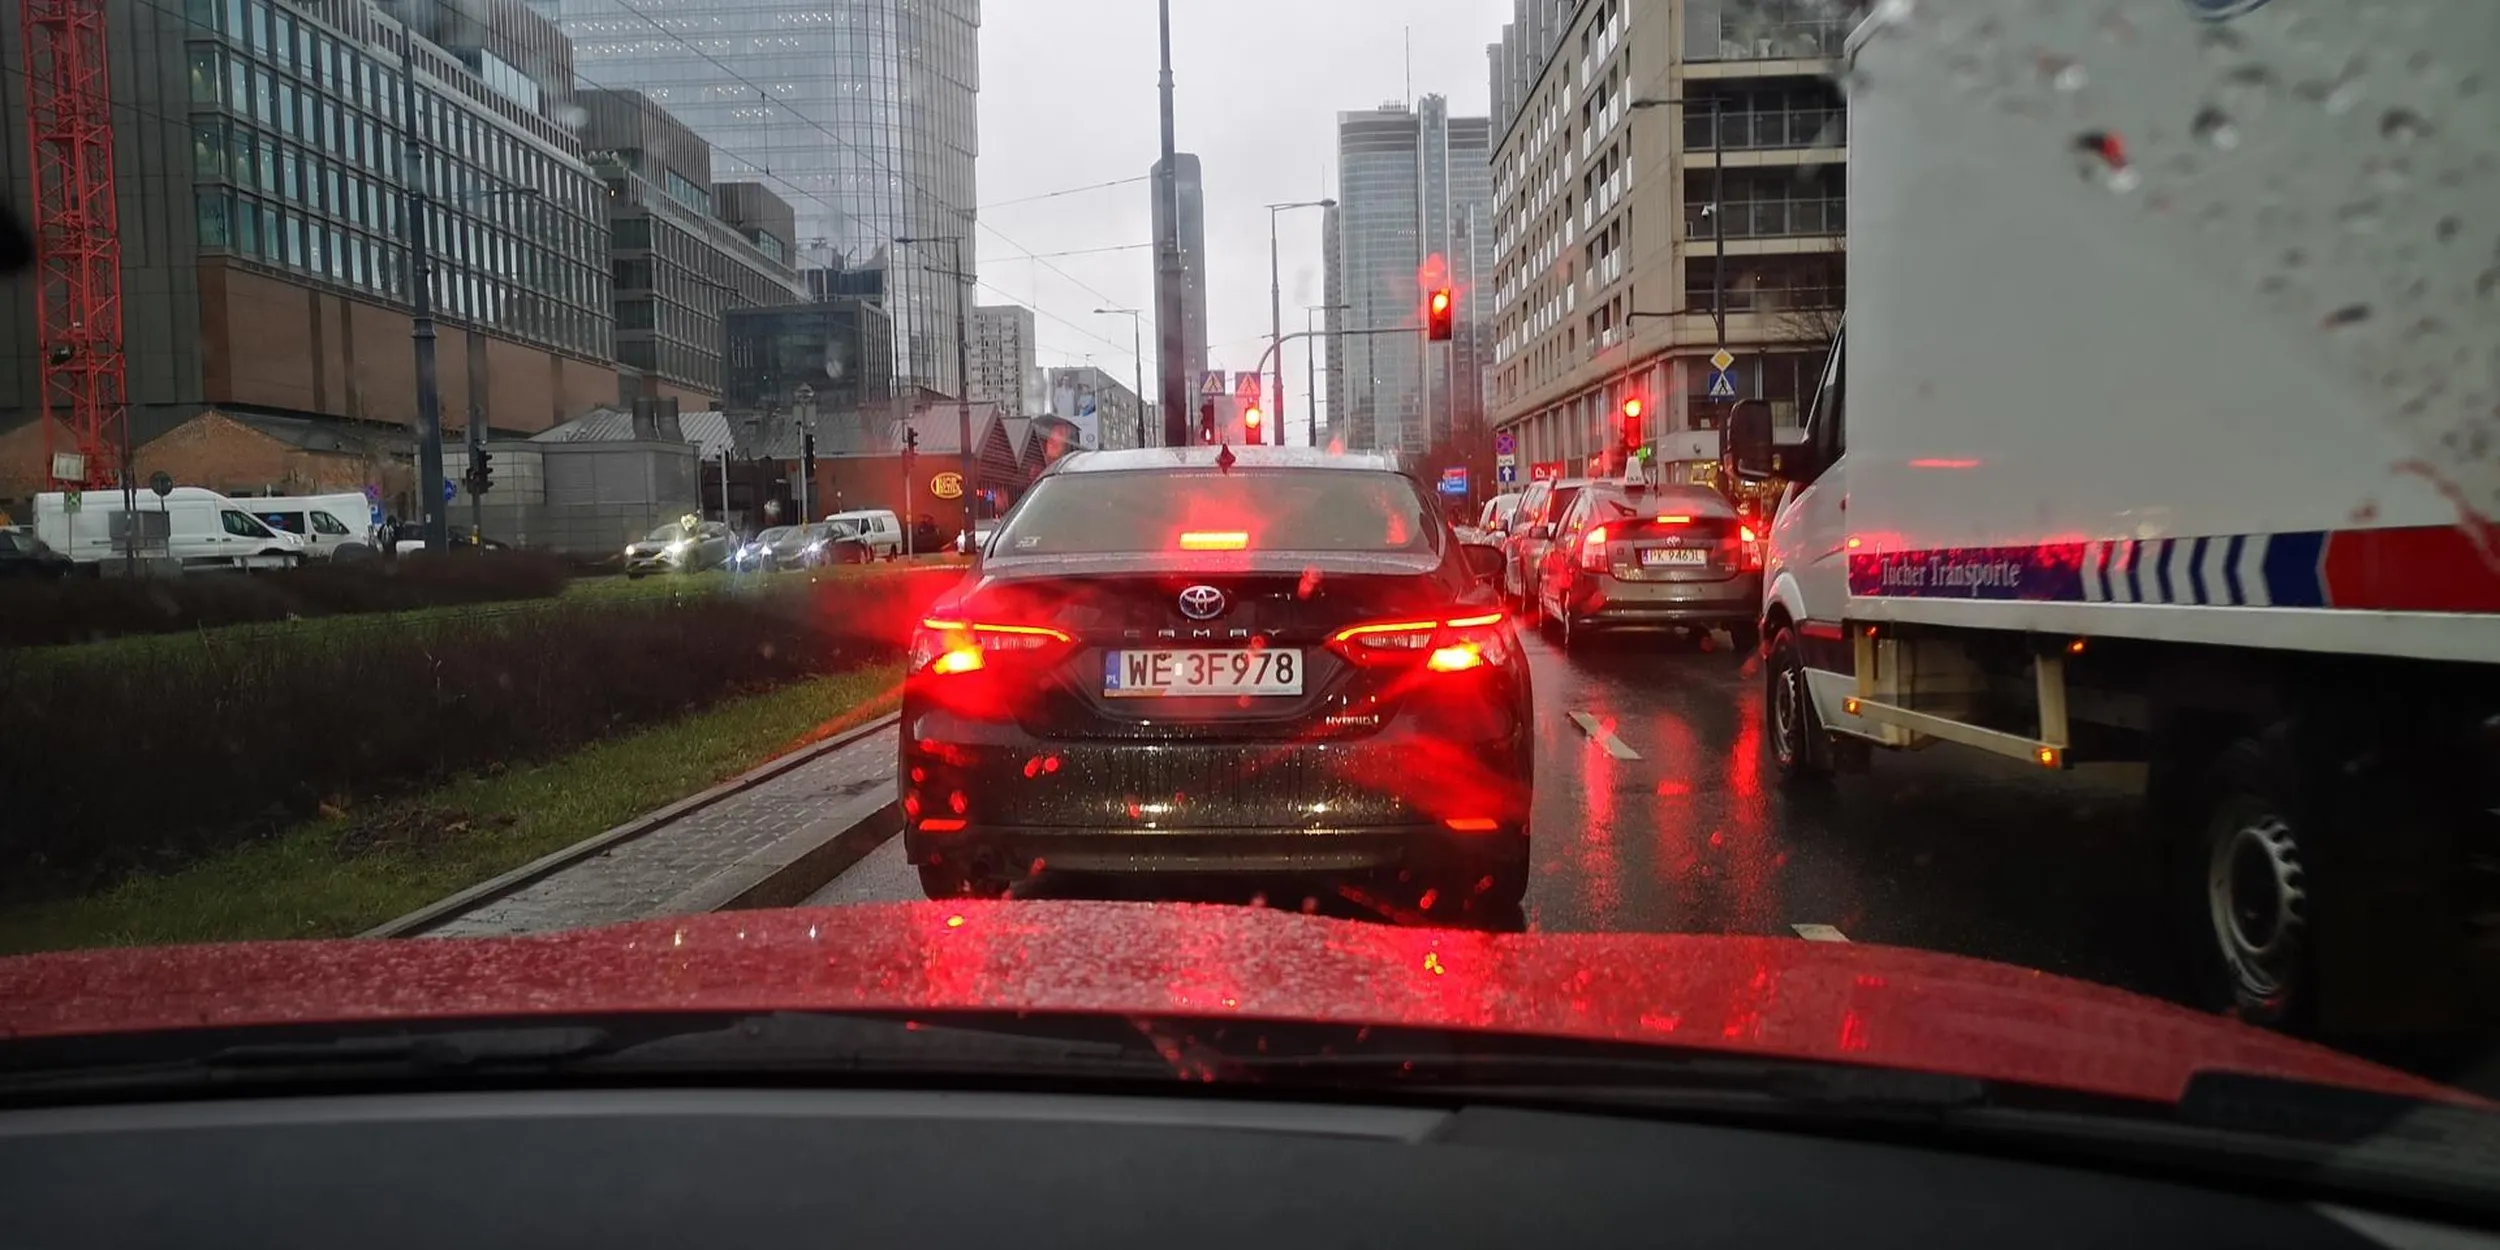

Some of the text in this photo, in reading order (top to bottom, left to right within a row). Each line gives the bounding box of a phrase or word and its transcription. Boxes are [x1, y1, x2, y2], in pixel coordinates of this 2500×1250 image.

[1880, 556, 2021, 597] Tucher Transporte
[1106, 674, 1119, 685] PL
[1128, 652, 1294, 685] WE 3F978
